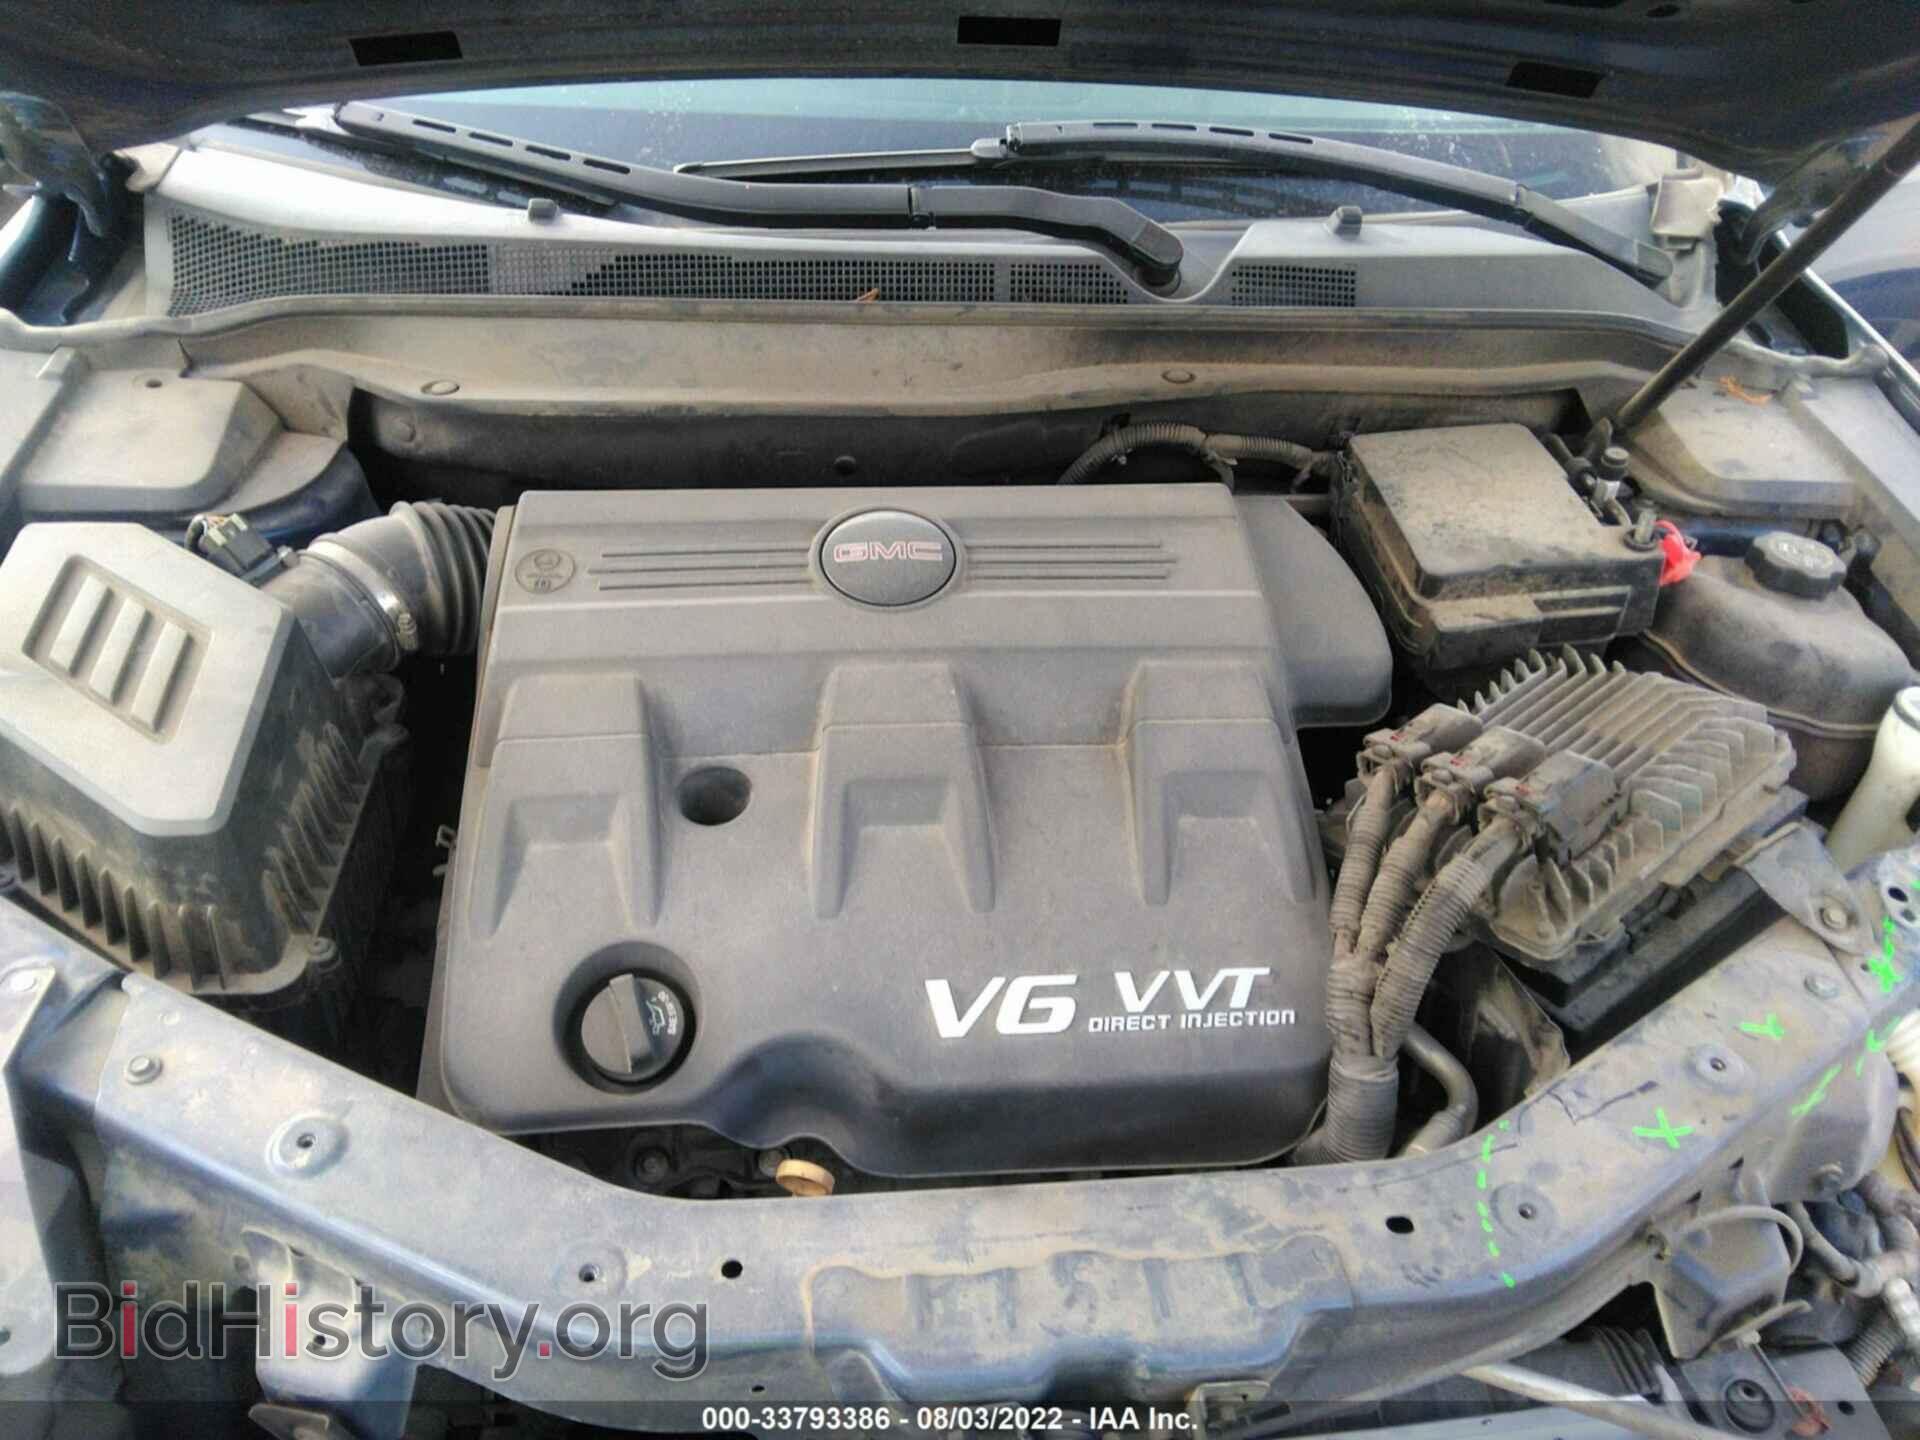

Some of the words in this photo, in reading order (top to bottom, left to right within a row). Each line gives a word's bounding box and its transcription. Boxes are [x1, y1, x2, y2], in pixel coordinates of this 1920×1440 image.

[834, 541, 943, 562] GMC
[925, 974, 1080, 1039] V6
[1114, 967, 1271, 1012] VVT
[1088, 1014, 1171, 1033] DIRECT
[1180, 1009, 1296, 1030] INJECTION
